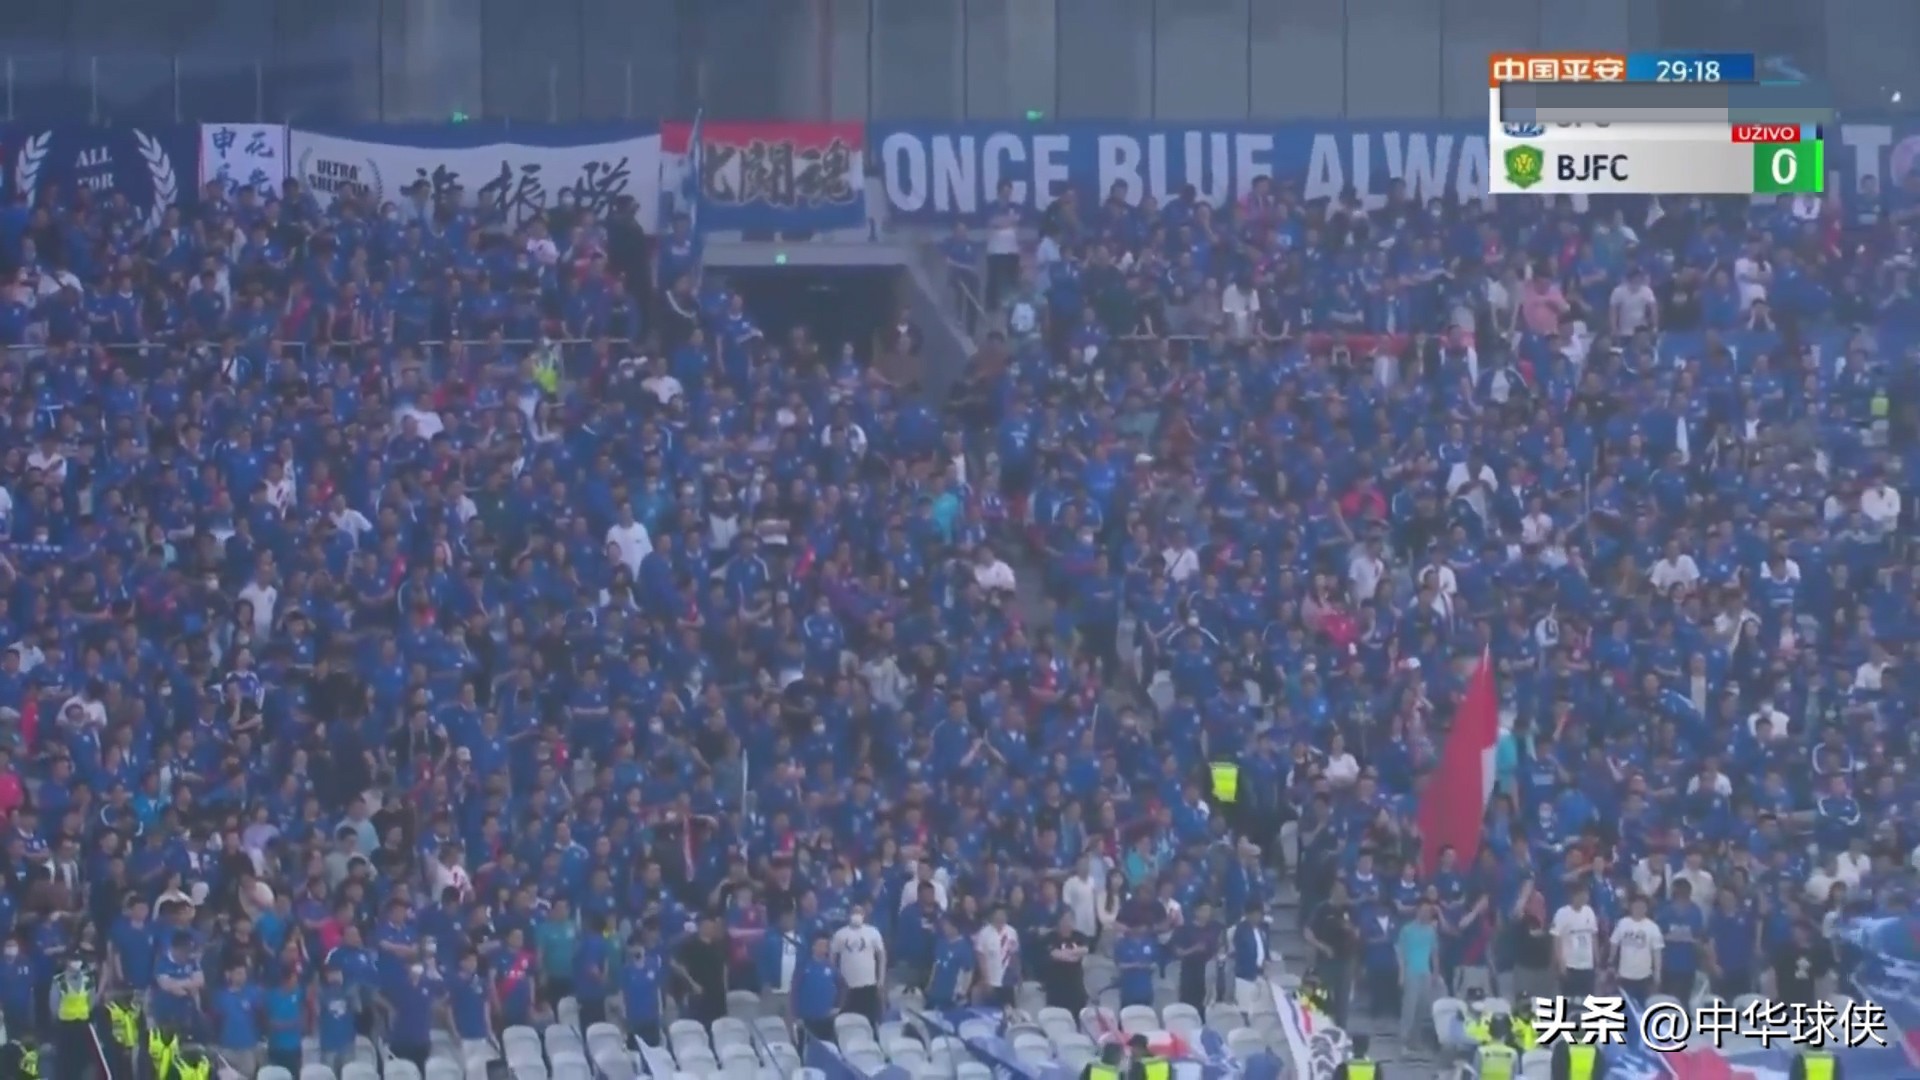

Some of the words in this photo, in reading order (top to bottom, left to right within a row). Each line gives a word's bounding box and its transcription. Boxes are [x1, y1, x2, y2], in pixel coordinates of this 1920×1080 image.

[75, 145, 113, 168] ALL
[316, 159, 358, 181] ULTRA
[882, 131, 1070, 212] ONCE
[1098, 131, 1274, 208] BLUE
